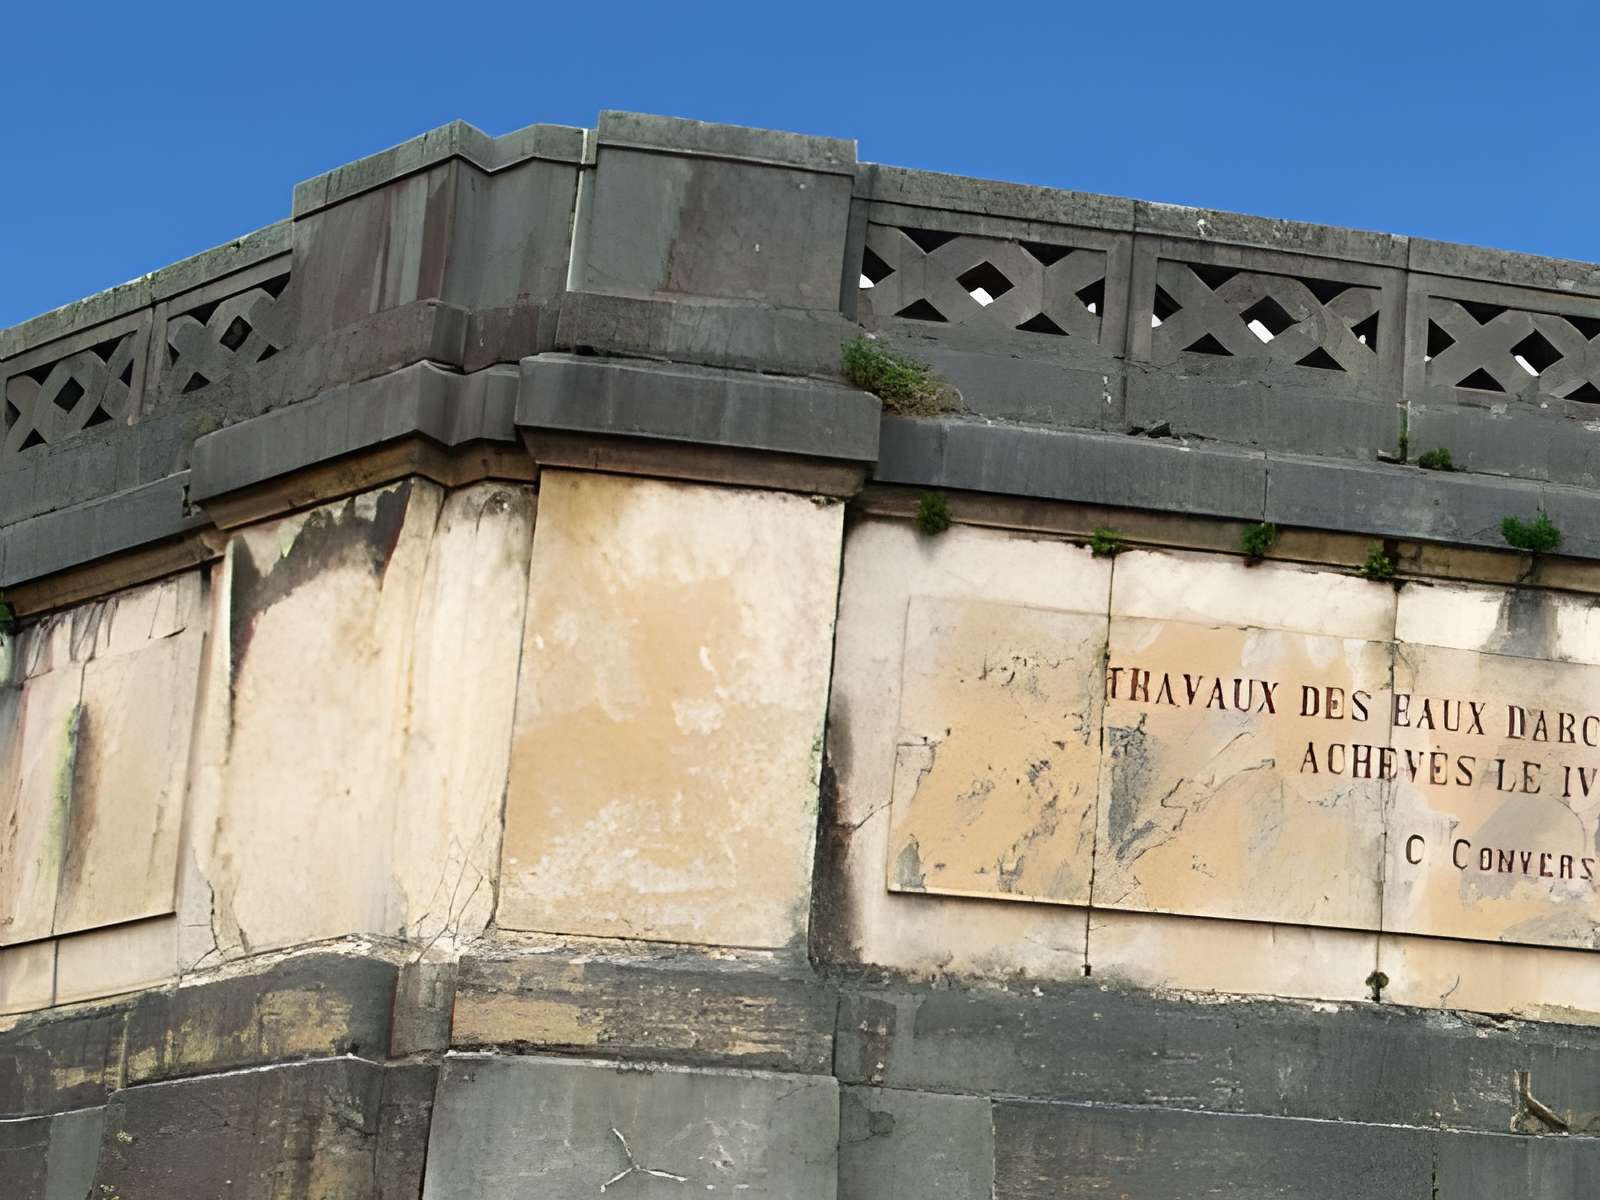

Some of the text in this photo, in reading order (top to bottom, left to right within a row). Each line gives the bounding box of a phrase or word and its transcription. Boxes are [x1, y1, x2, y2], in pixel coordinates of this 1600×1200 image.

[1106, 667, 1279, 714] TRAVAUX
[1300, 684, 1372, 722] DES
[1394, 693, 1487, 735] EAUX
[1495, 758, 1542, 794] LE
[1562, 765, 1599, 798] IV
